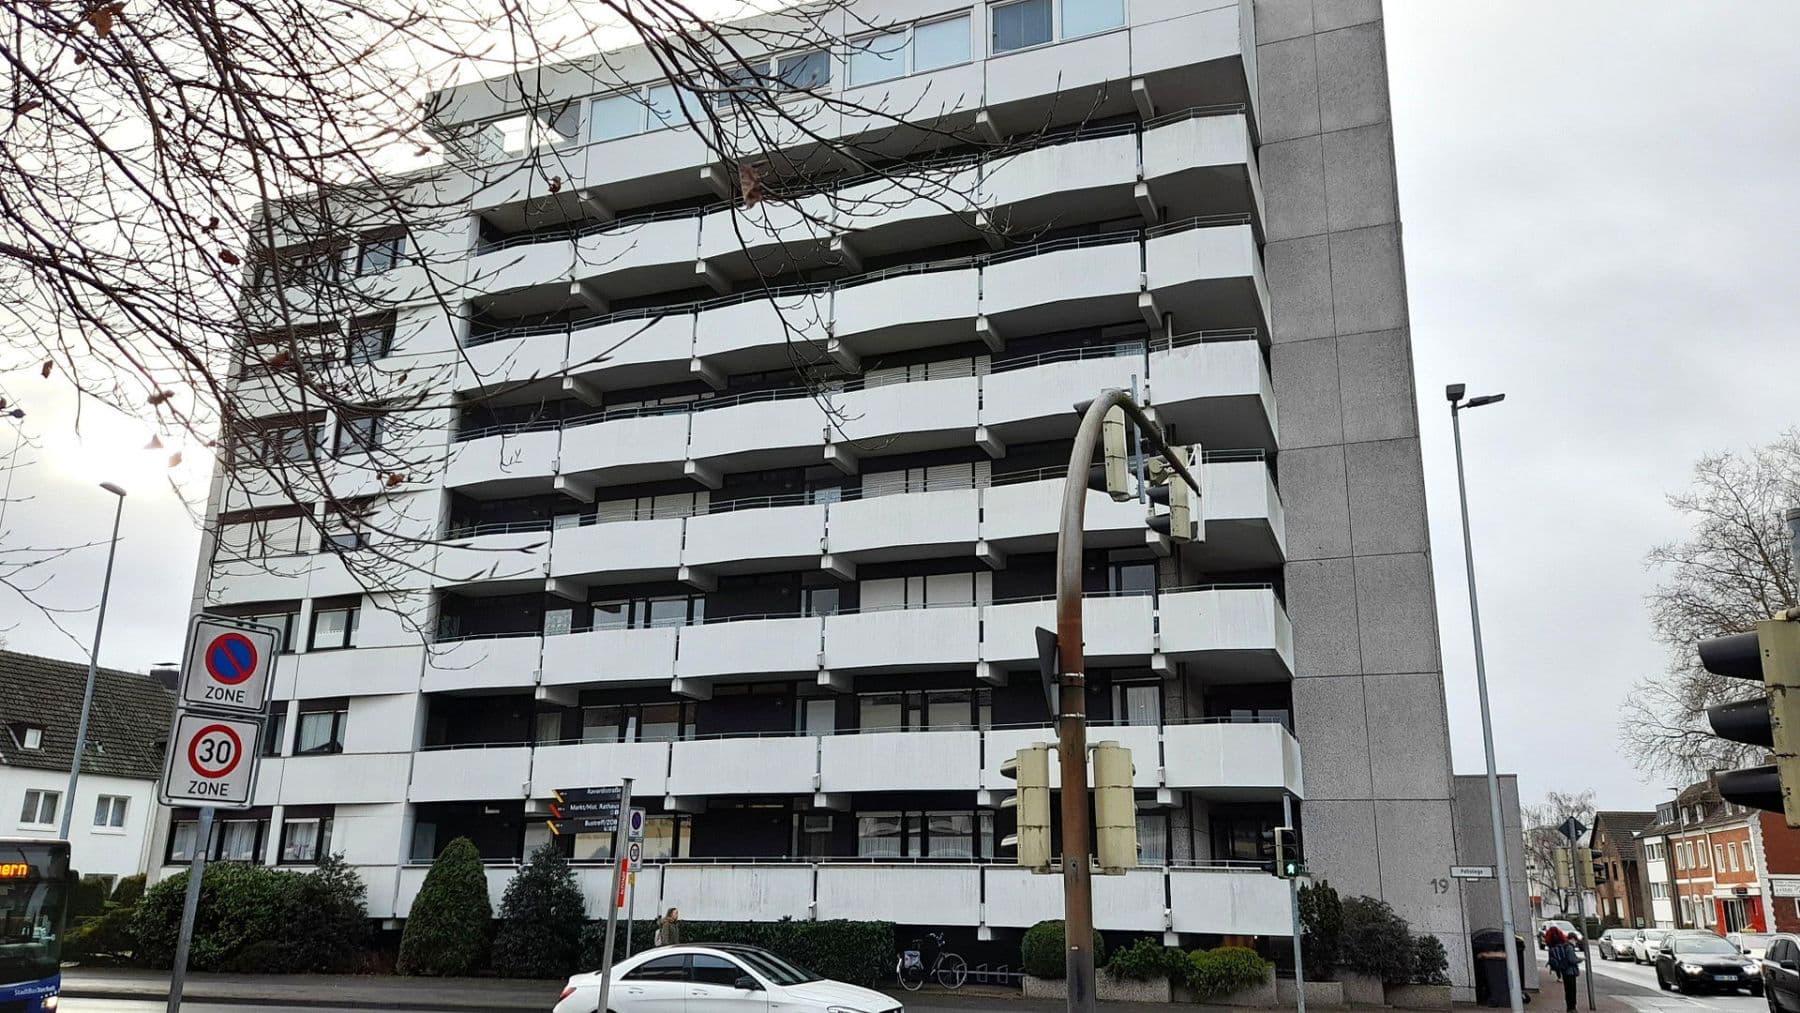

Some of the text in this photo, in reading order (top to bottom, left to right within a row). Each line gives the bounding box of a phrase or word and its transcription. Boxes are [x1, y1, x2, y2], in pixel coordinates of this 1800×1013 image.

[205, 686, 245, 703] ZONE
[199, 738, 231, 764] 30
[188, 780, 229, 796] ZONE
[1430, 878, 1449, 894] 19
